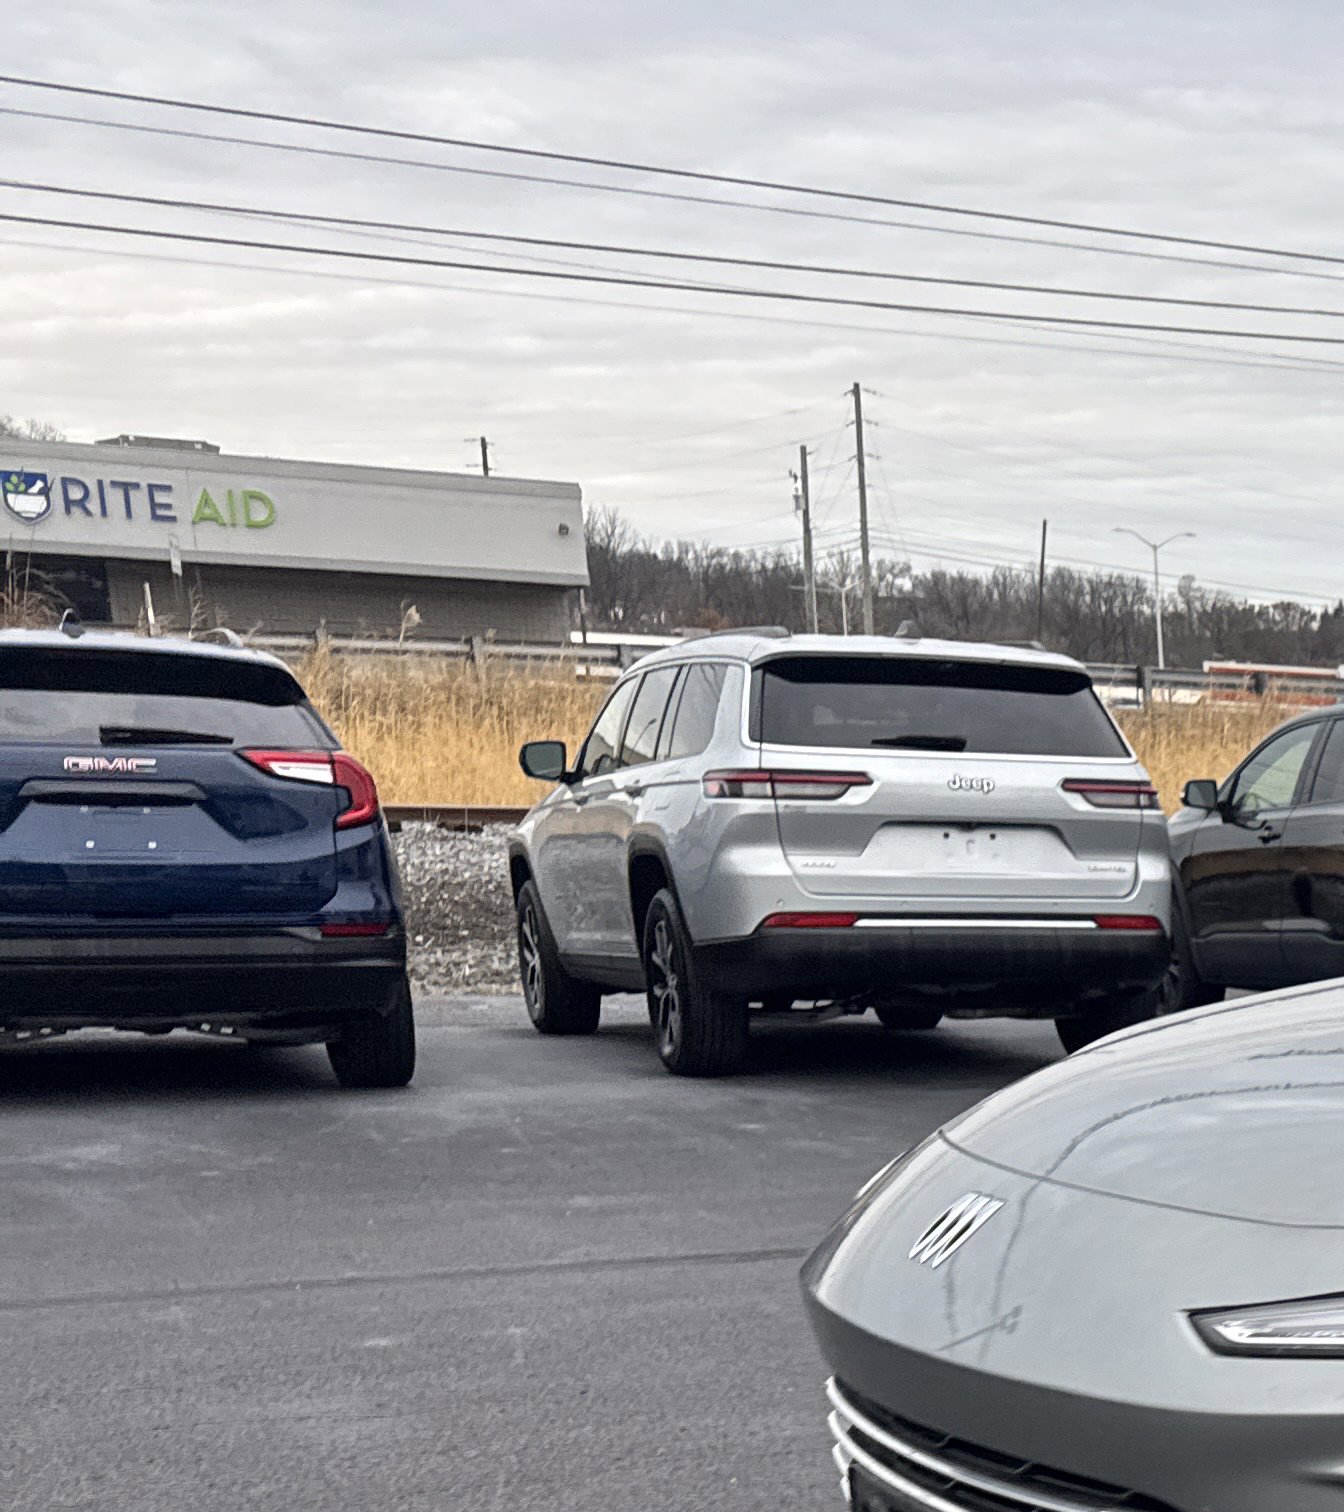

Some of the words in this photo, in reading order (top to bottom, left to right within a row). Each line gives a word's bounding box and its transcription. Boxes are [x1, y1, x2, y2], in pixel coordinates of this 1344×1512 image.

[60, 477, 177, 522] RITE
[191, 489, 276, 528] AID
[64, 757, 157, 772] GMC
[947, 775, 995, 794] Jeep
